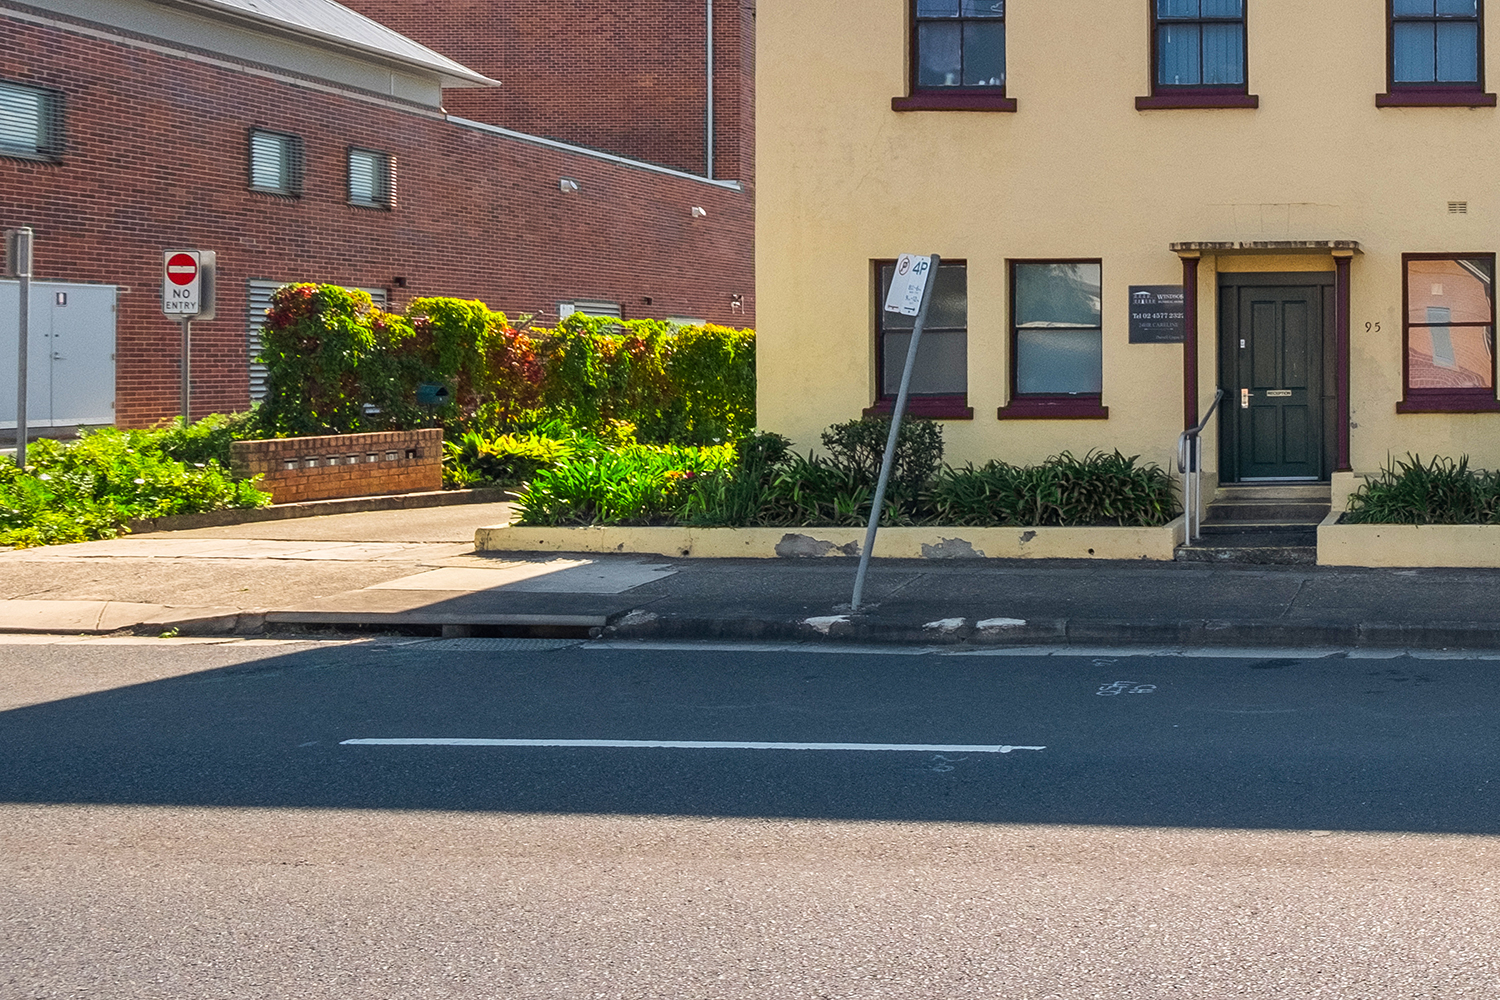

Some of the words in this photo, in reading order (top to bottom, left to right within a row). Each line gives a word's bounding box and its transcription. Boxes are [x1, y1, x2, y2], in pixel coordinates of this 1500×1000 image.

[912, 261, 928, 275] 4P
[173, 289, 190, 299] NO
[166, 301, 196, 310] ENTRY
[1365, 321, 1381, 333] 95
